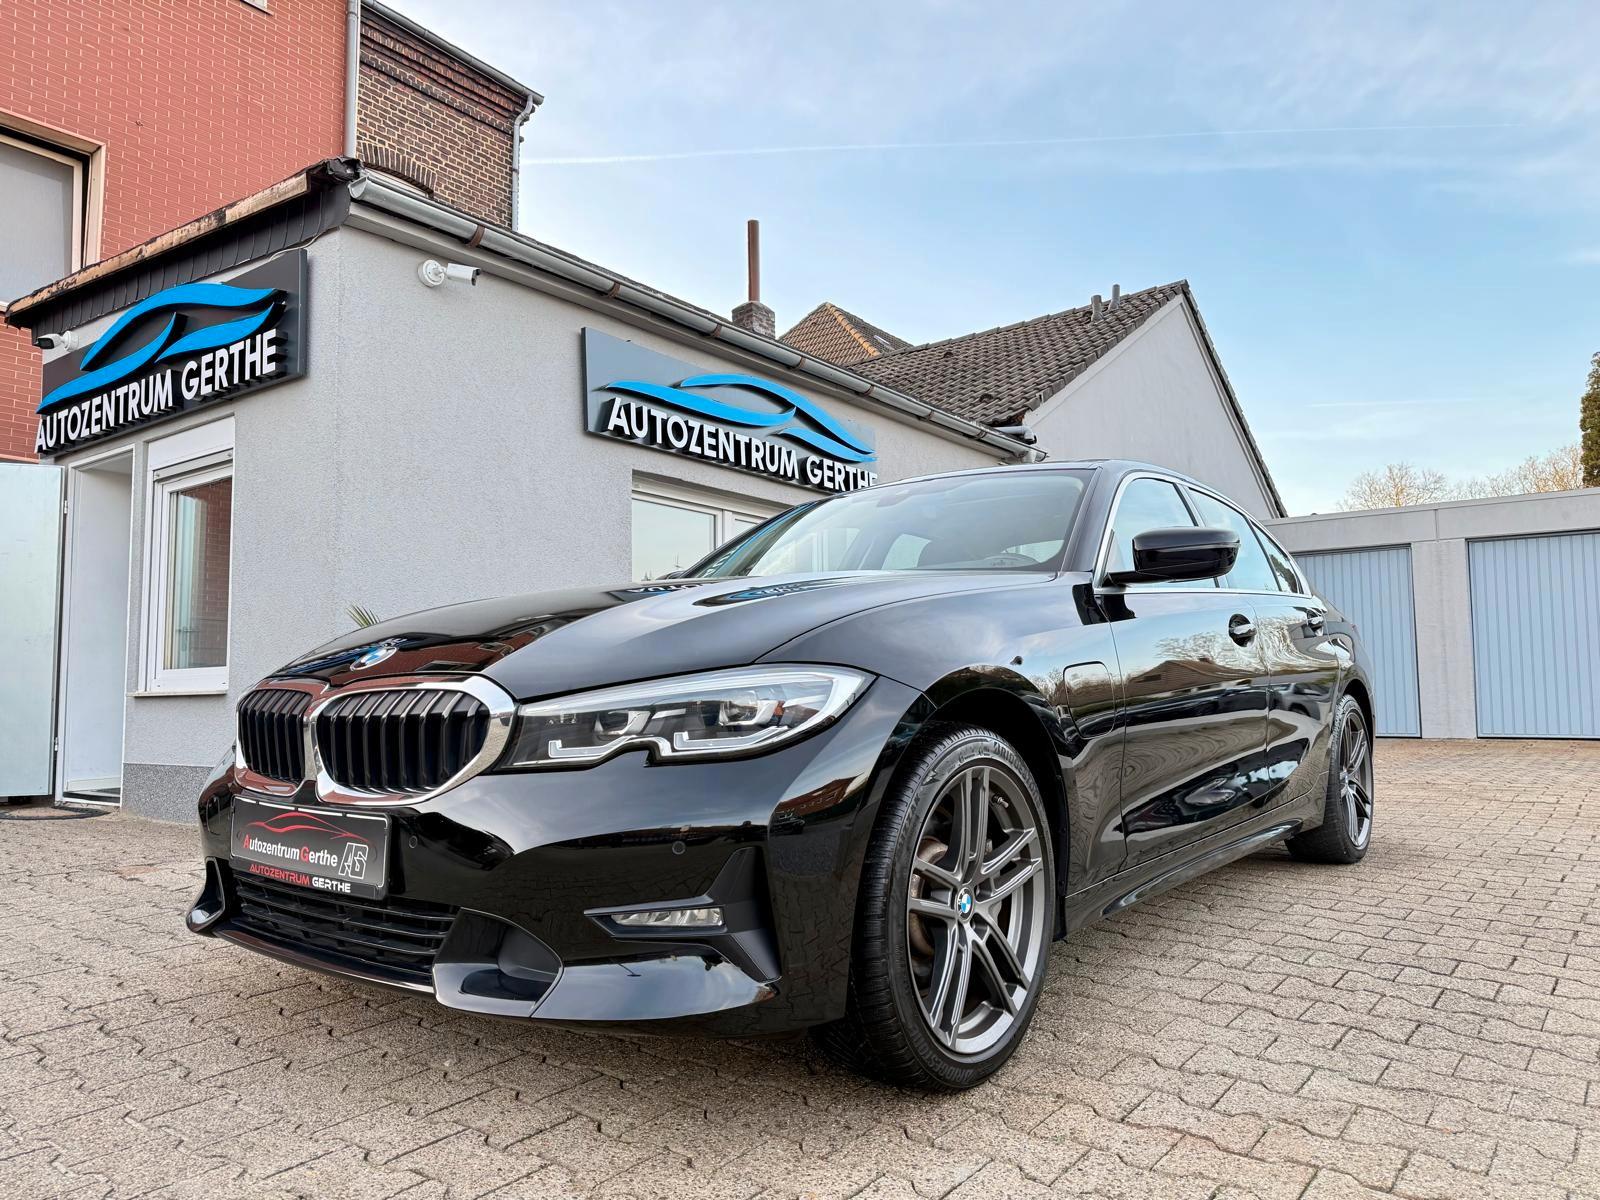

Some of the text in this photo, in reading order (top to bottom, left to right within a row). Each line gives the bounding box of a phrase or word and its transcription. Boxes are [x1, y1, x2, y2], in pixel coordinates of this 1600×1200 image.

[34, 328, 277, 454] AUTOZENTRUM GERTHE
[607, 397, 799, 479] AUTOZENTRUM
[243, 834, 338, 867] Autozentrum Gerthe
[249, 863, 351, 893] AUTOZENTRUM GERTHE
